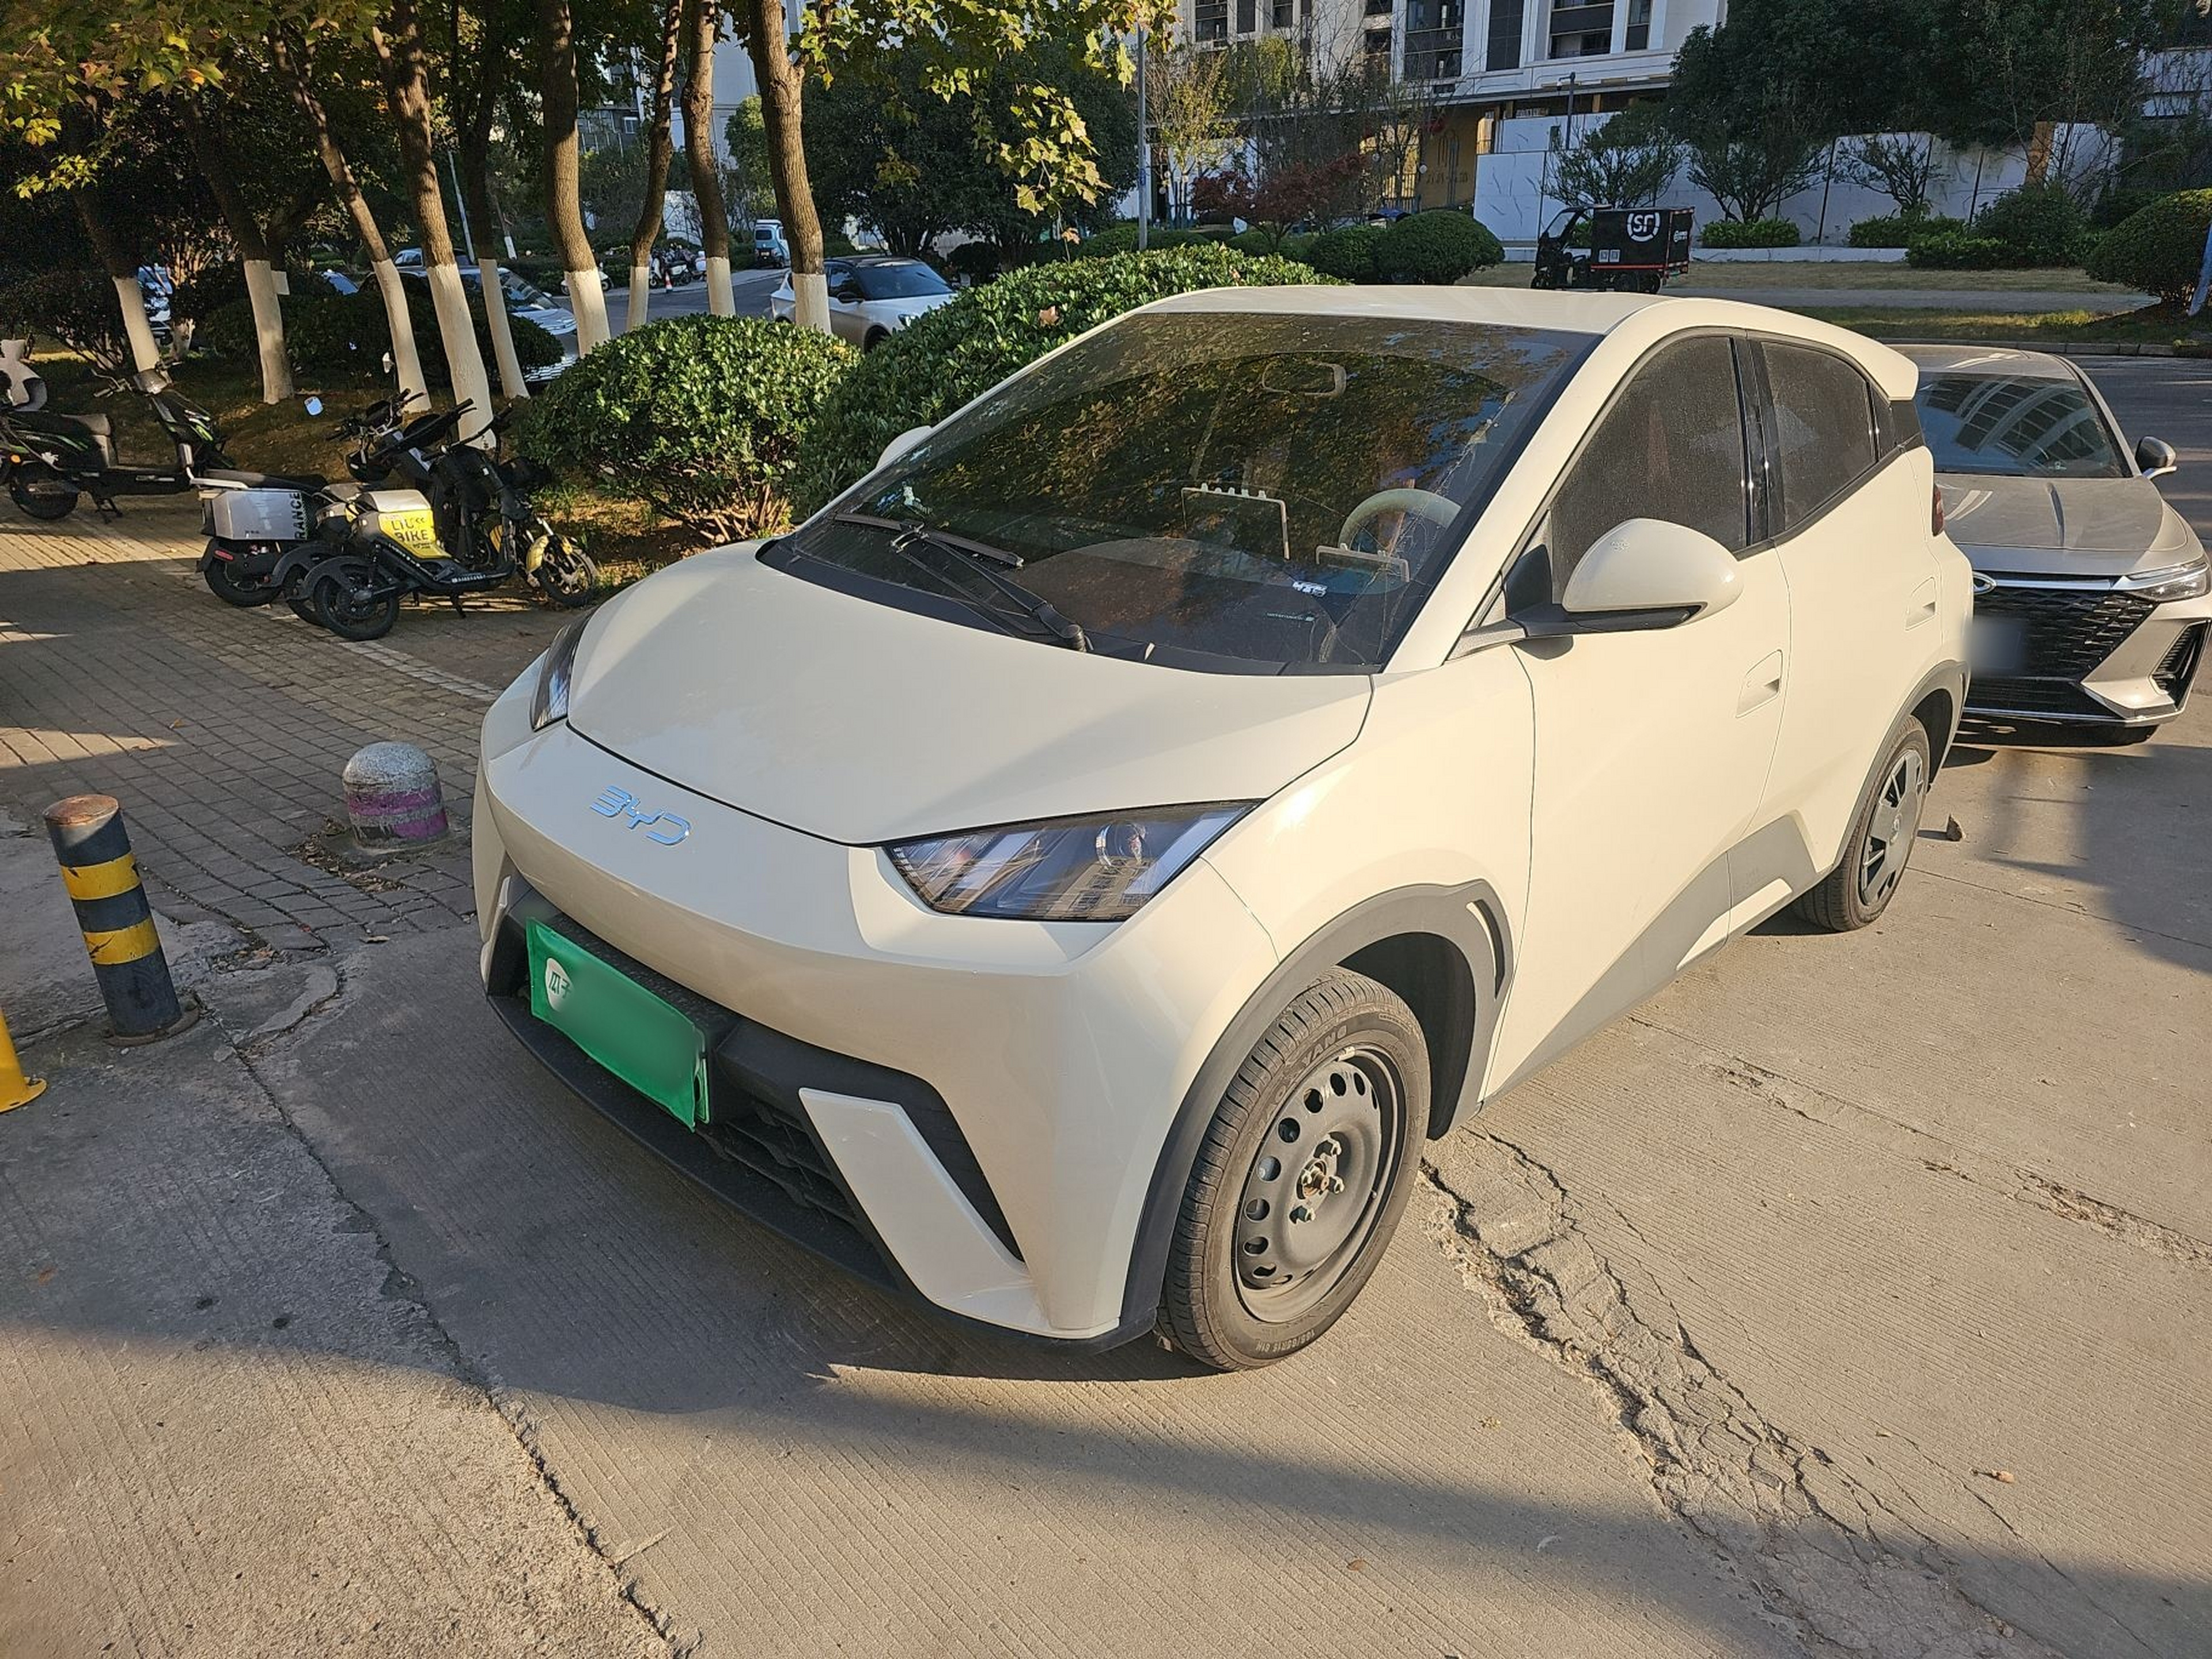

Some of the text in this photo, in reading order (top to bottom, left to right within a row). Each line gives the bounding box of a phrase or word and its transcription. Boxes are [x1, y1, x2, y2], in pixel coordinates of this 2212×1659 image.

[394, 529, 429, 542] BIKE
[590, 785, 692, 847] BYD
[548, 970, 570, 999] 瓜子
